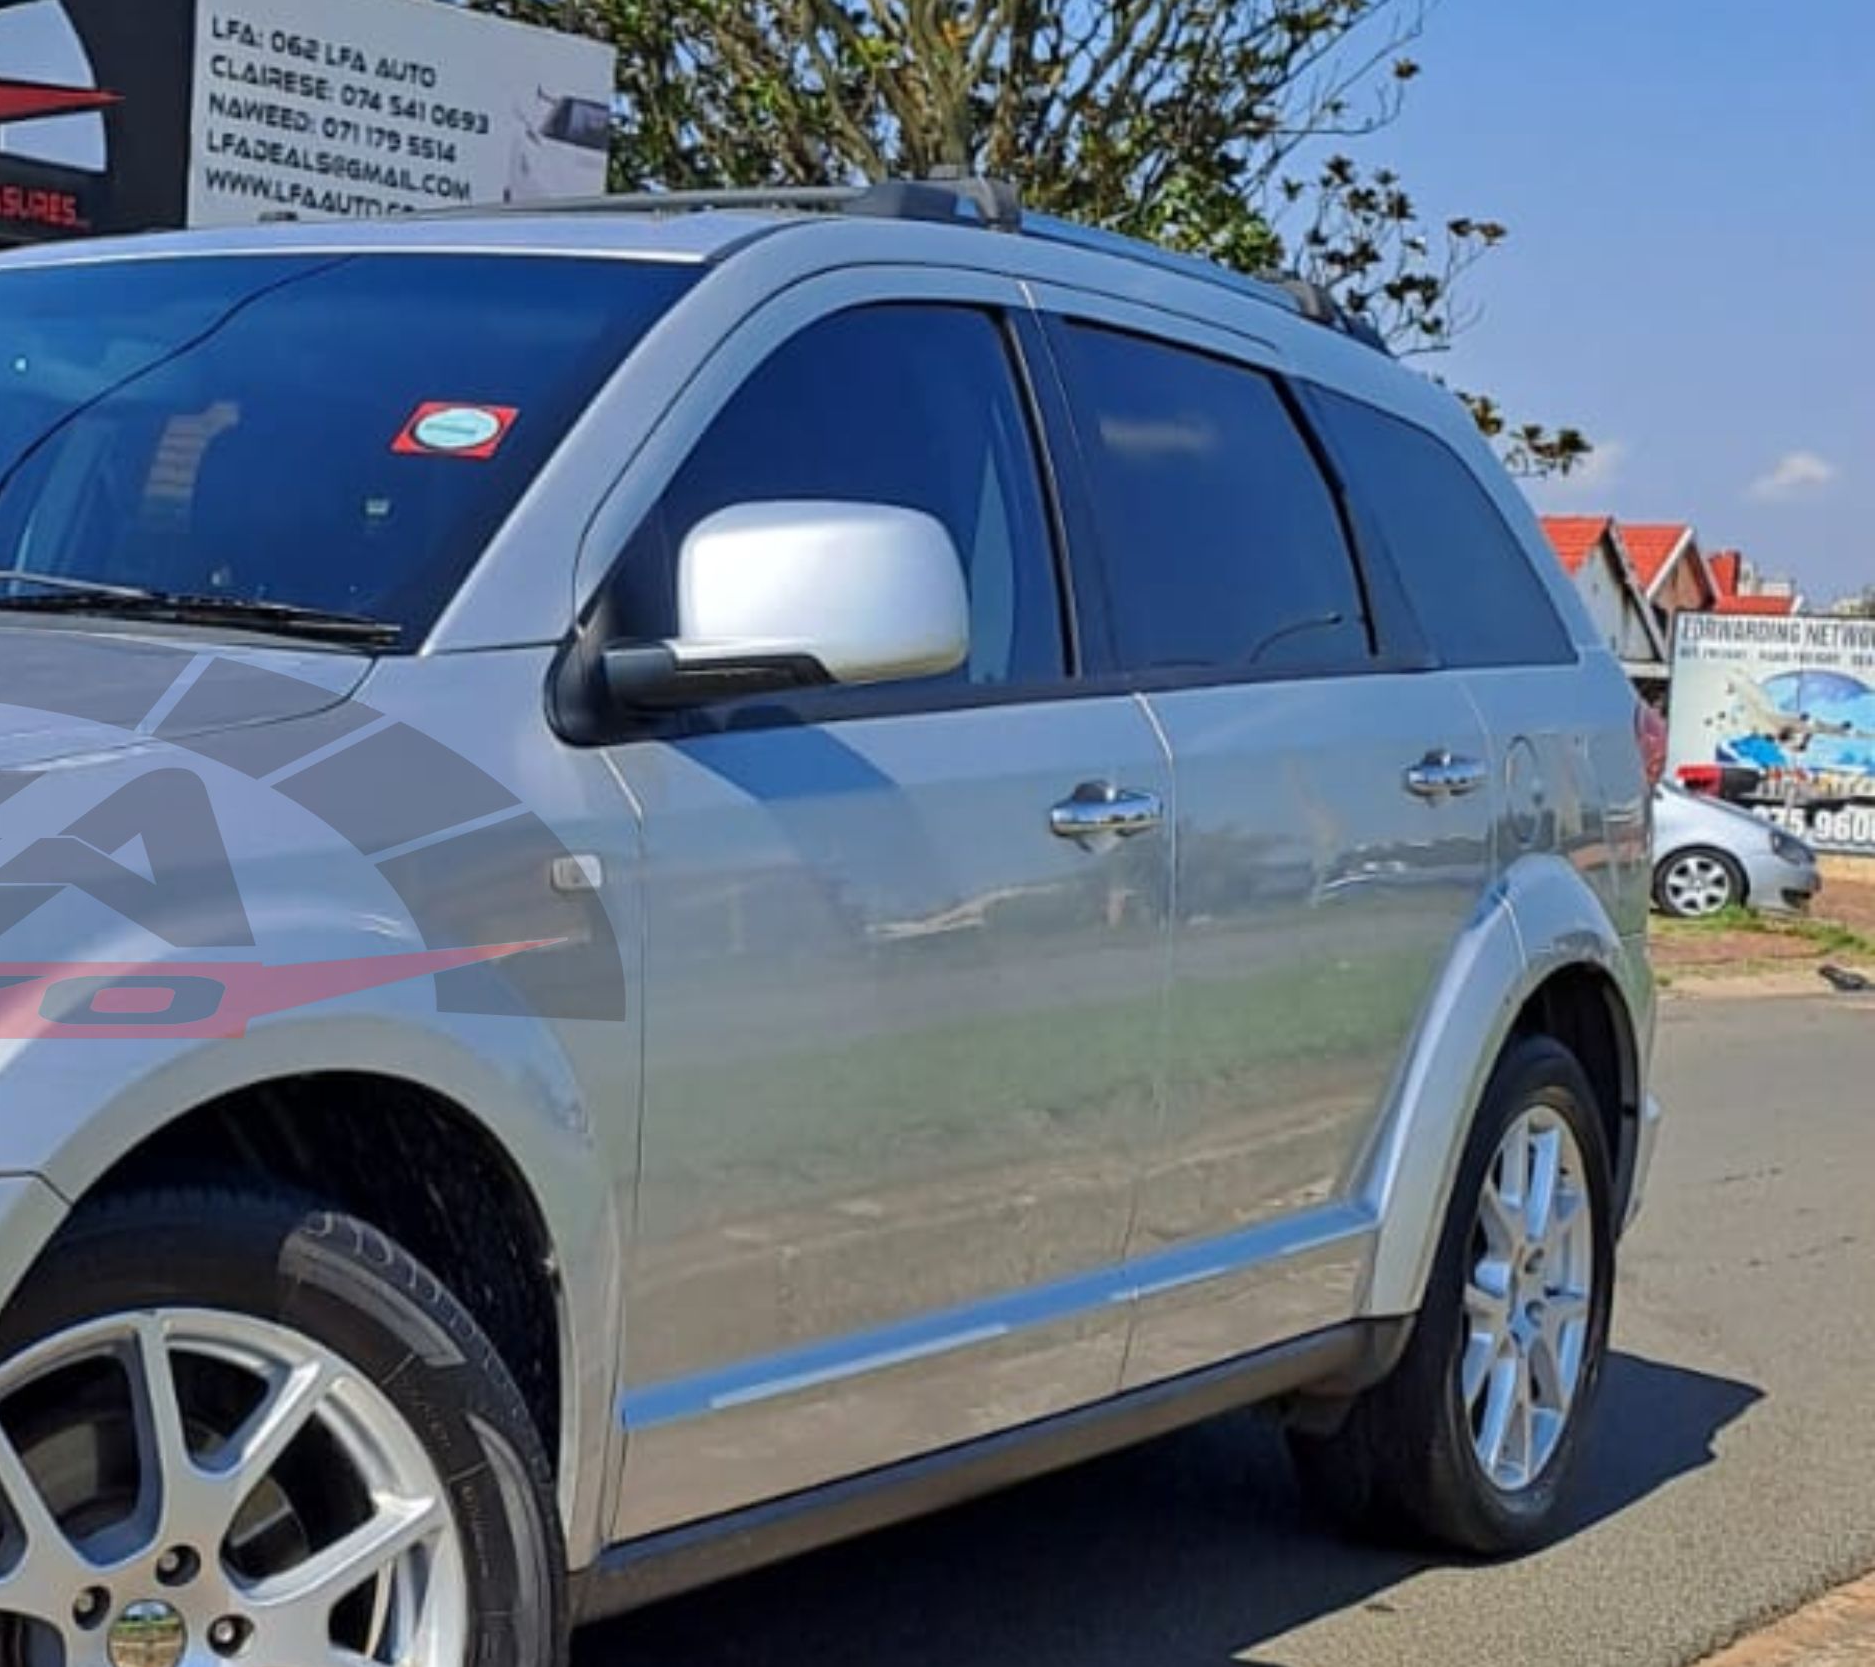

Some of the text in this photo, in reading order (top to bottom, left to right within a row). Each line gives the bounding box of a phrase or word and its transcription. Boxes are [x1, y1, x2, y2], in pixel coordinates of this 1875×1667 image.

[212, 16, 436, 88] LFA: 062 LFA AUTO
[340, 85, 381, 110] 074
[390, 96, 425, 121] 541
[207, 129, 470, 202] LFADEALS@GMAIL.COM
[322, 117, 359, 143] 071
[365, 125, 400, 152] 179
[408, 135, 456, 163] 5514
